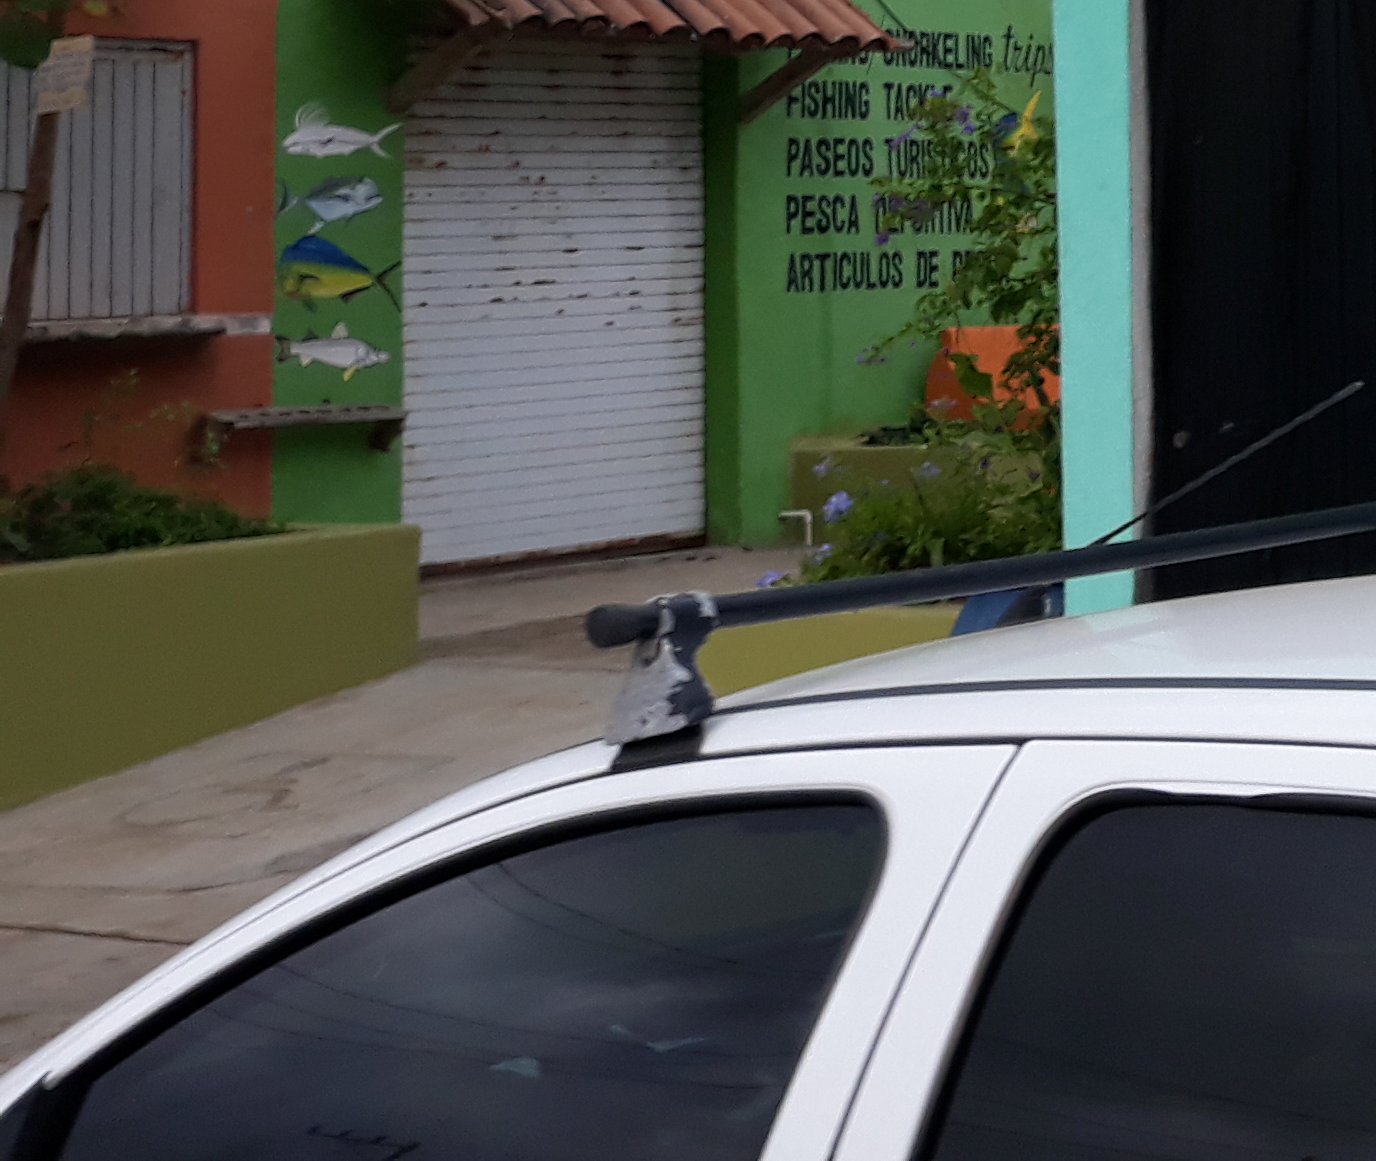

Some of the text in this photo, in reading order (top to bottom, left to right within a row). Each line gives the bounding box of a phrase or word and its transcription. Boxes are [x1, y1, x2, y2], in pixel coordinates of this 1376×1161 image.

[786, 80, 954, 121] FISHING TACK
[787, 137, 875, 179] PASEOS
[786, 193, 860, 235] PESCA
[787, 250, 903, 292] ARTICULOS
[916, 250, 939, 288] DE
